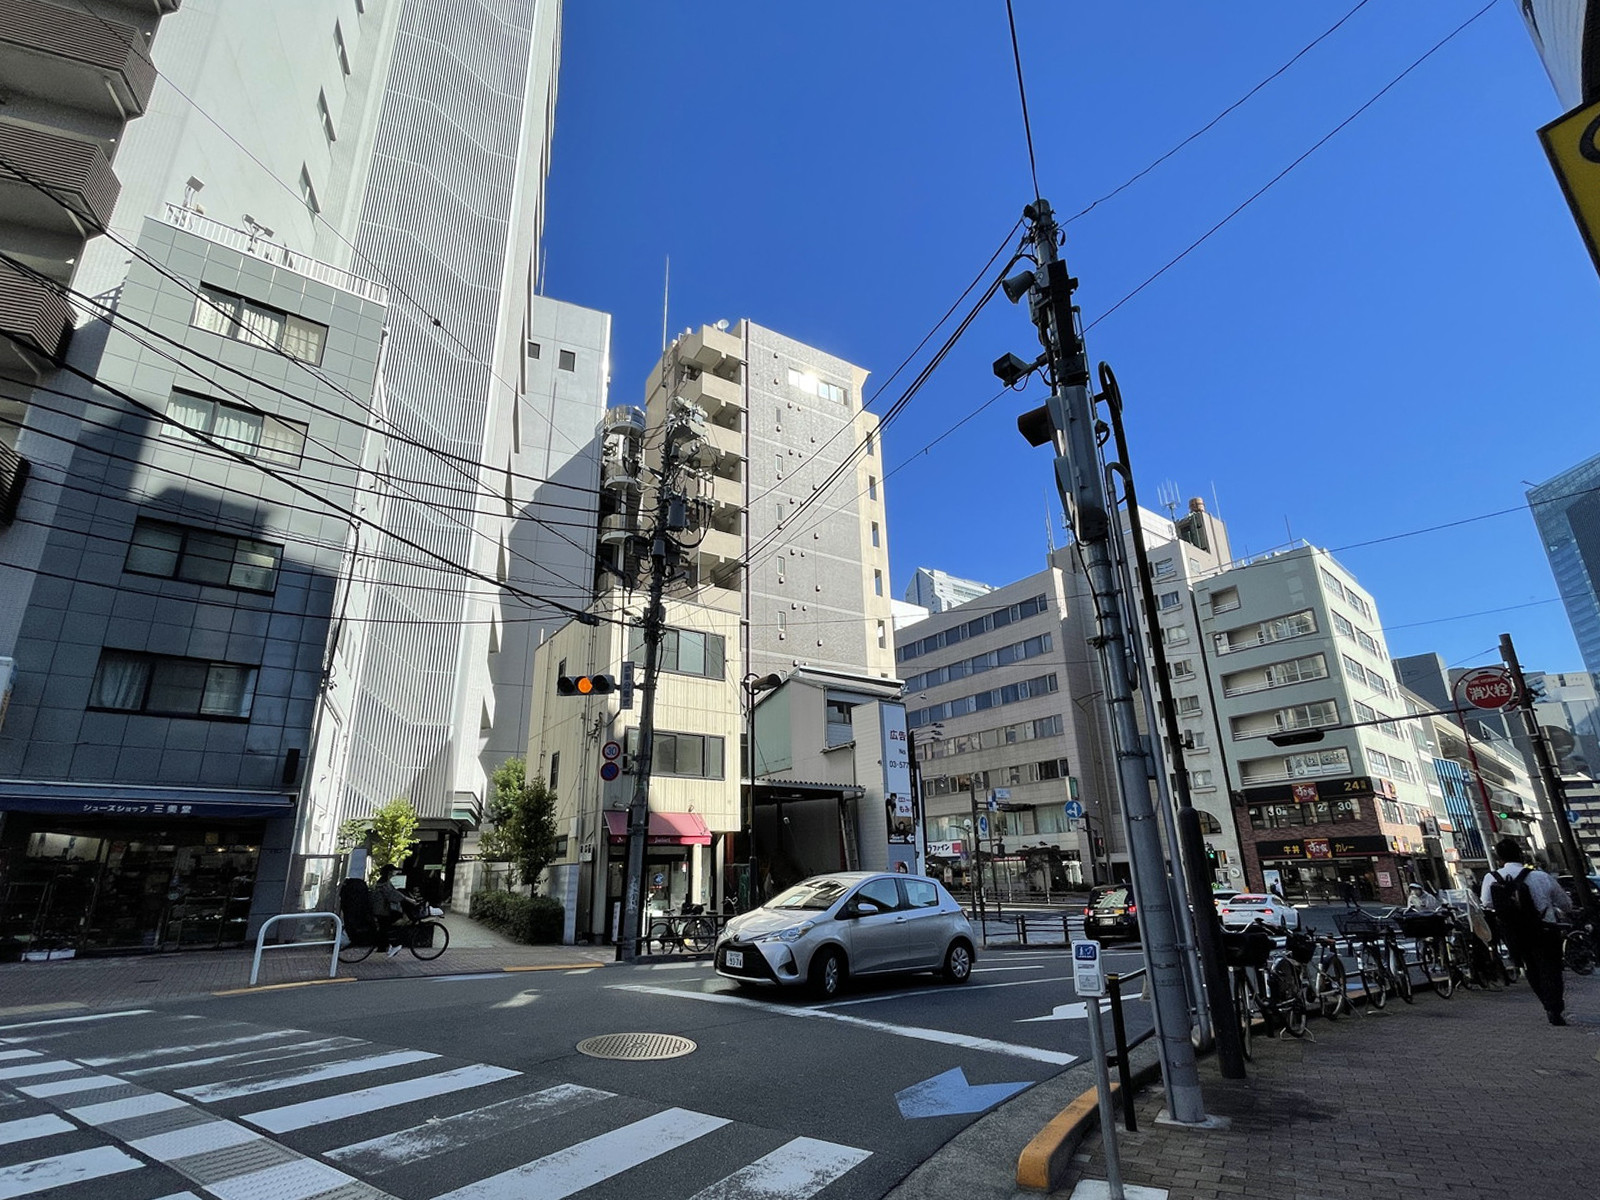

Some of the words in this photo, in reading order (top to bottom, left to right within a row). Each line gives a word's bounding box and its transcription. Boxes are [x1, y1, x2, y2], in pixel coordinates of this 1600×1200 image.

[1468, 683, 1509, 700] 消火栓
[606, 746, 617, 756] 30
[83, 804, 148, 812] シューズショップ
[1283, 845, 1301, 855] 牛丼
[1335, 842, 1356, 853] カレー
